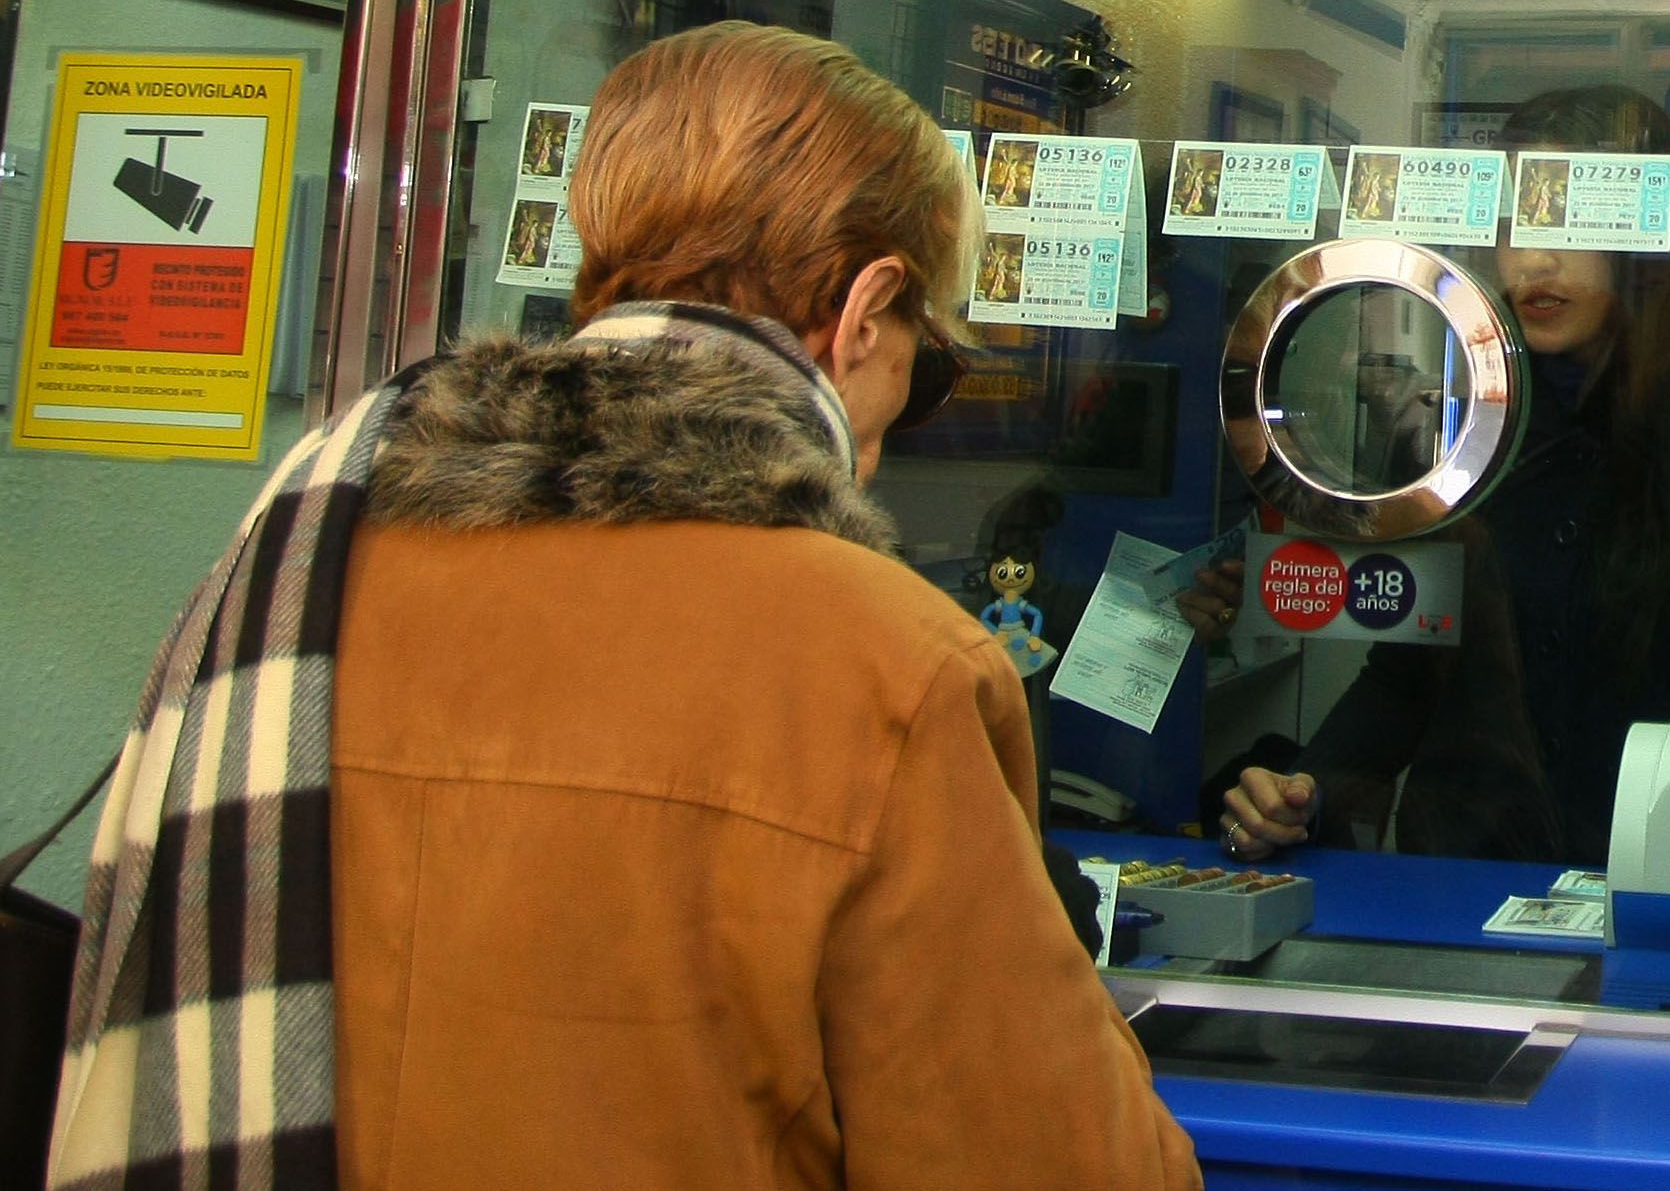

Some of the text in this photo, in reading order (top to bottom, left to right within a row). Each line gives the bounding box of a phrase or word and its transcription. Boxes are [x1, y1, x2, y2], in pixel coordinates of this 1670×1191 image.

[84, 81, 268, 99] ZONA VIDEOVIGILADA
[1039, 148, 1103, 161] 05136
[1226, 157, 1290, 170] 02328
[1404, 161, 1470, 175] 60490
[1573, 166, 1641, 179] 07279
[1107, 196, 1117, 204] 20
[1296, 204, 1306, 212] 20
[1476, 209, 1486, 217] 20
[1649, 214, 1659, 222] 20
[1027, 241, 1091, 256] 05136
[229, 282, 243, 292] DE
[1097, 292, 1107, 300] 20
[135, 366, 147, 374] DE
[207, 368, 218, 377] DE
[221, 369, 249, 378] DATOS
[133, 386, 179, 396] DERECHOS
[1270, 561, 1339, 577] Primera
[1265, 578, 1343, 595] regla del
[1354, 570, 1404, 597] +18
[1274, 594, 1331, 612] juego:
[1356, 595, 1399, 611] años
